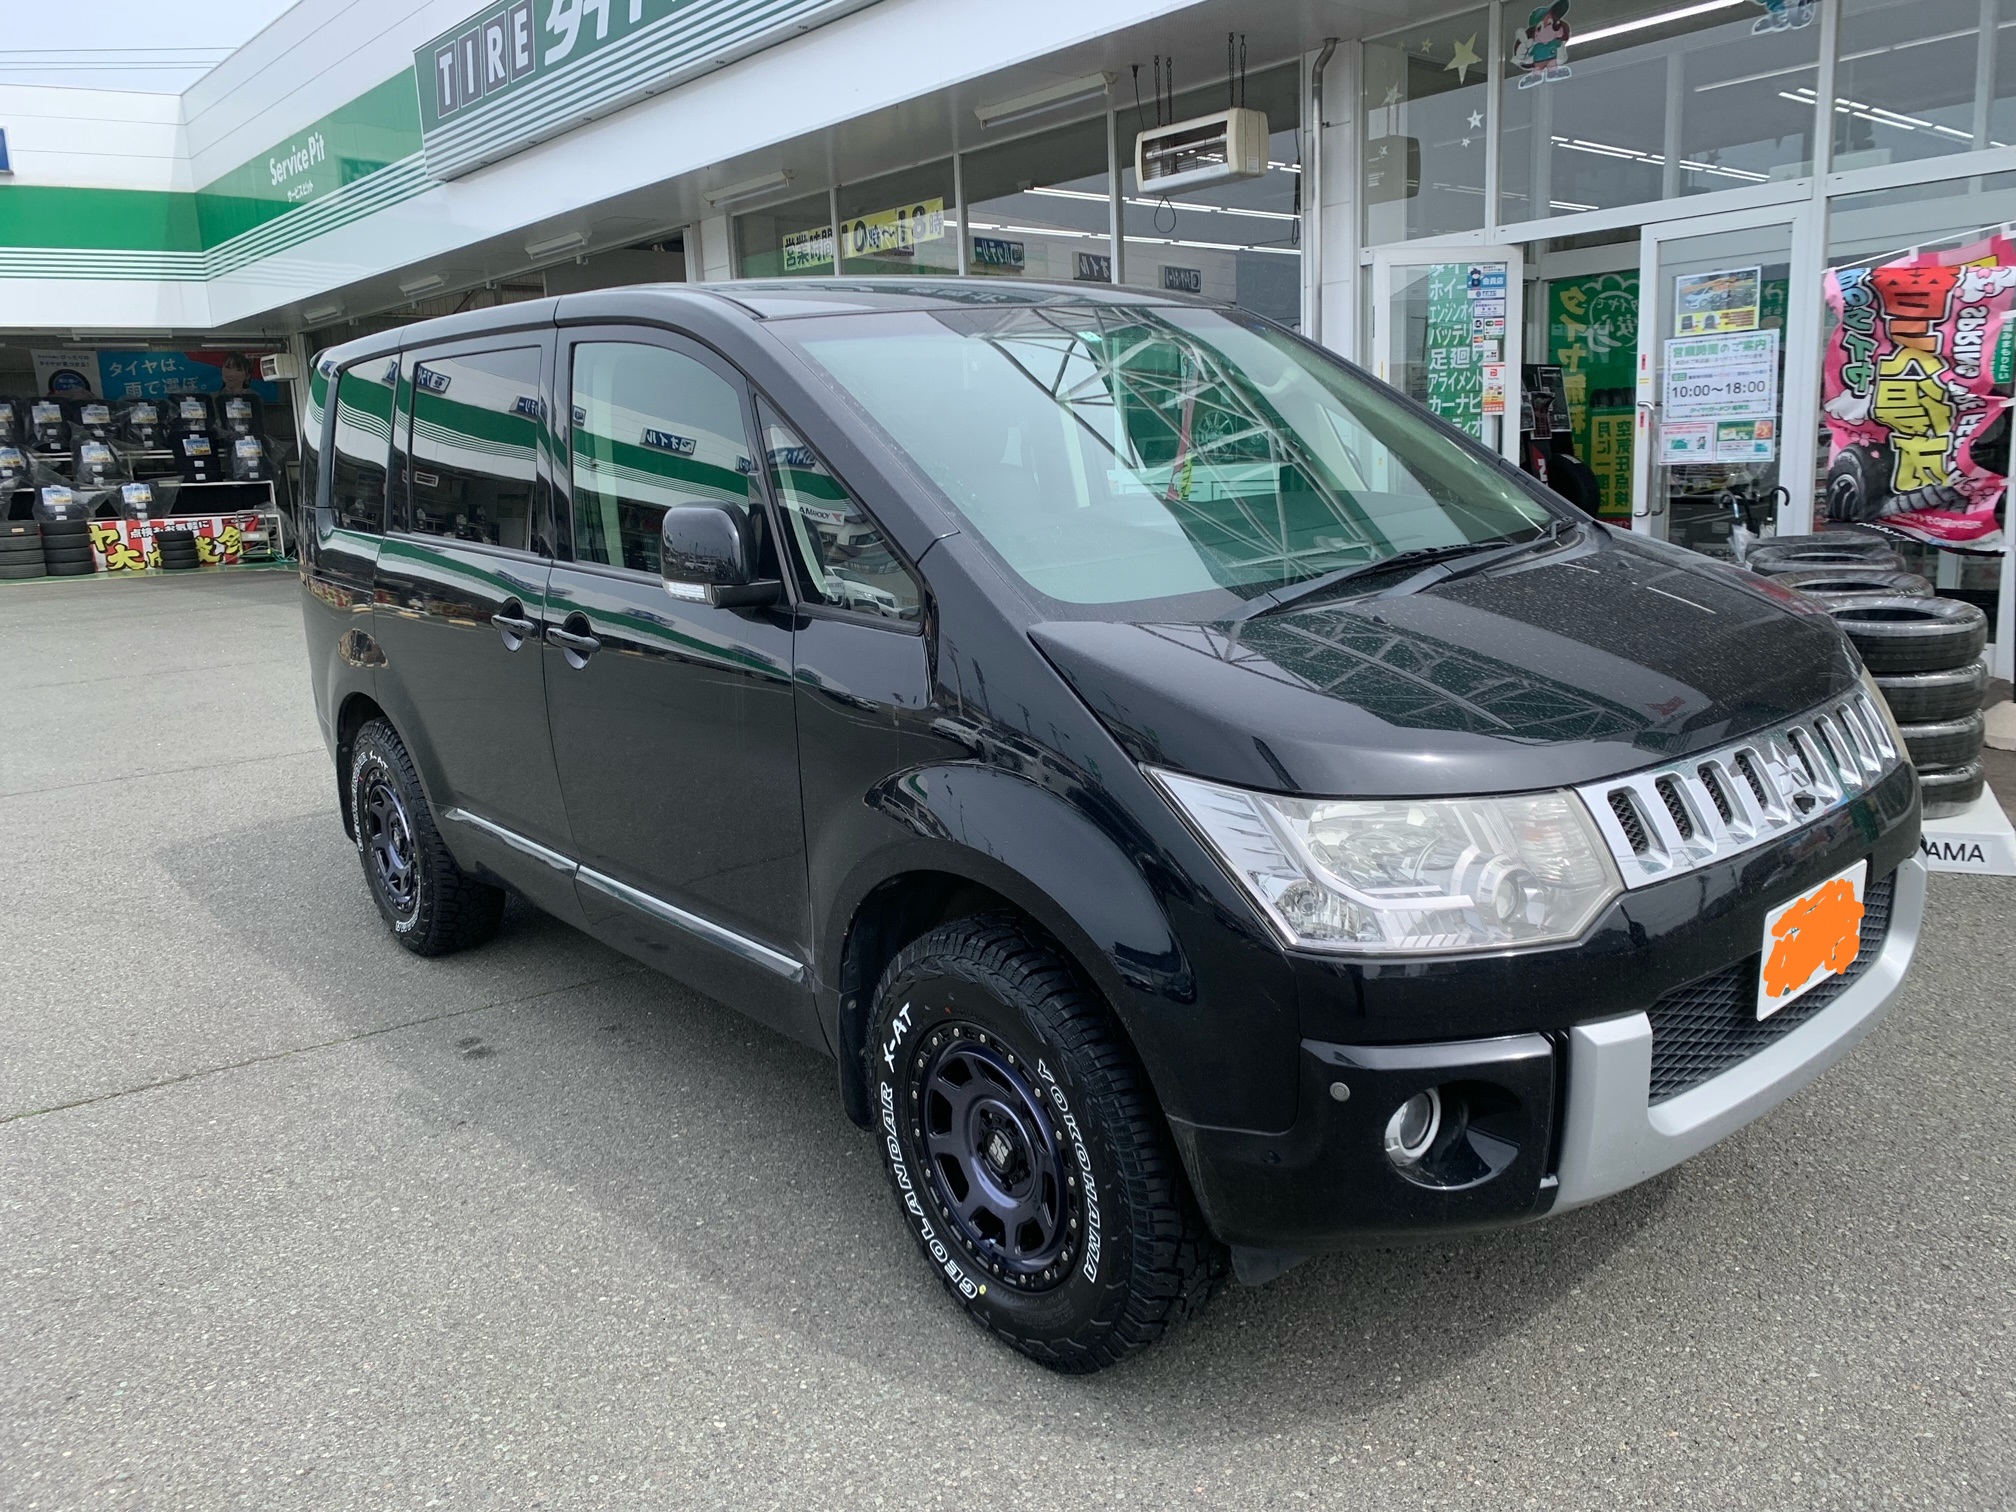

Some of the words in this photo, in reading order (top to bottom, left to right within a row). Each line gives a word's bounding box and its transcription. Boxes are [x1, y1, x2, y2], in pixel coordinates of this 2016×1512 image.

[438, 6, 529, 106] TIRE
[269, 145, 309, 186] Service
[307, 131, 325, 166] Pit
[882, 1002, 912, 1073] X-AT
[880, 1081, 978, 1299] GEOLANDAR
[1038, 1059, 1101, 1283] YOKOHAMA
